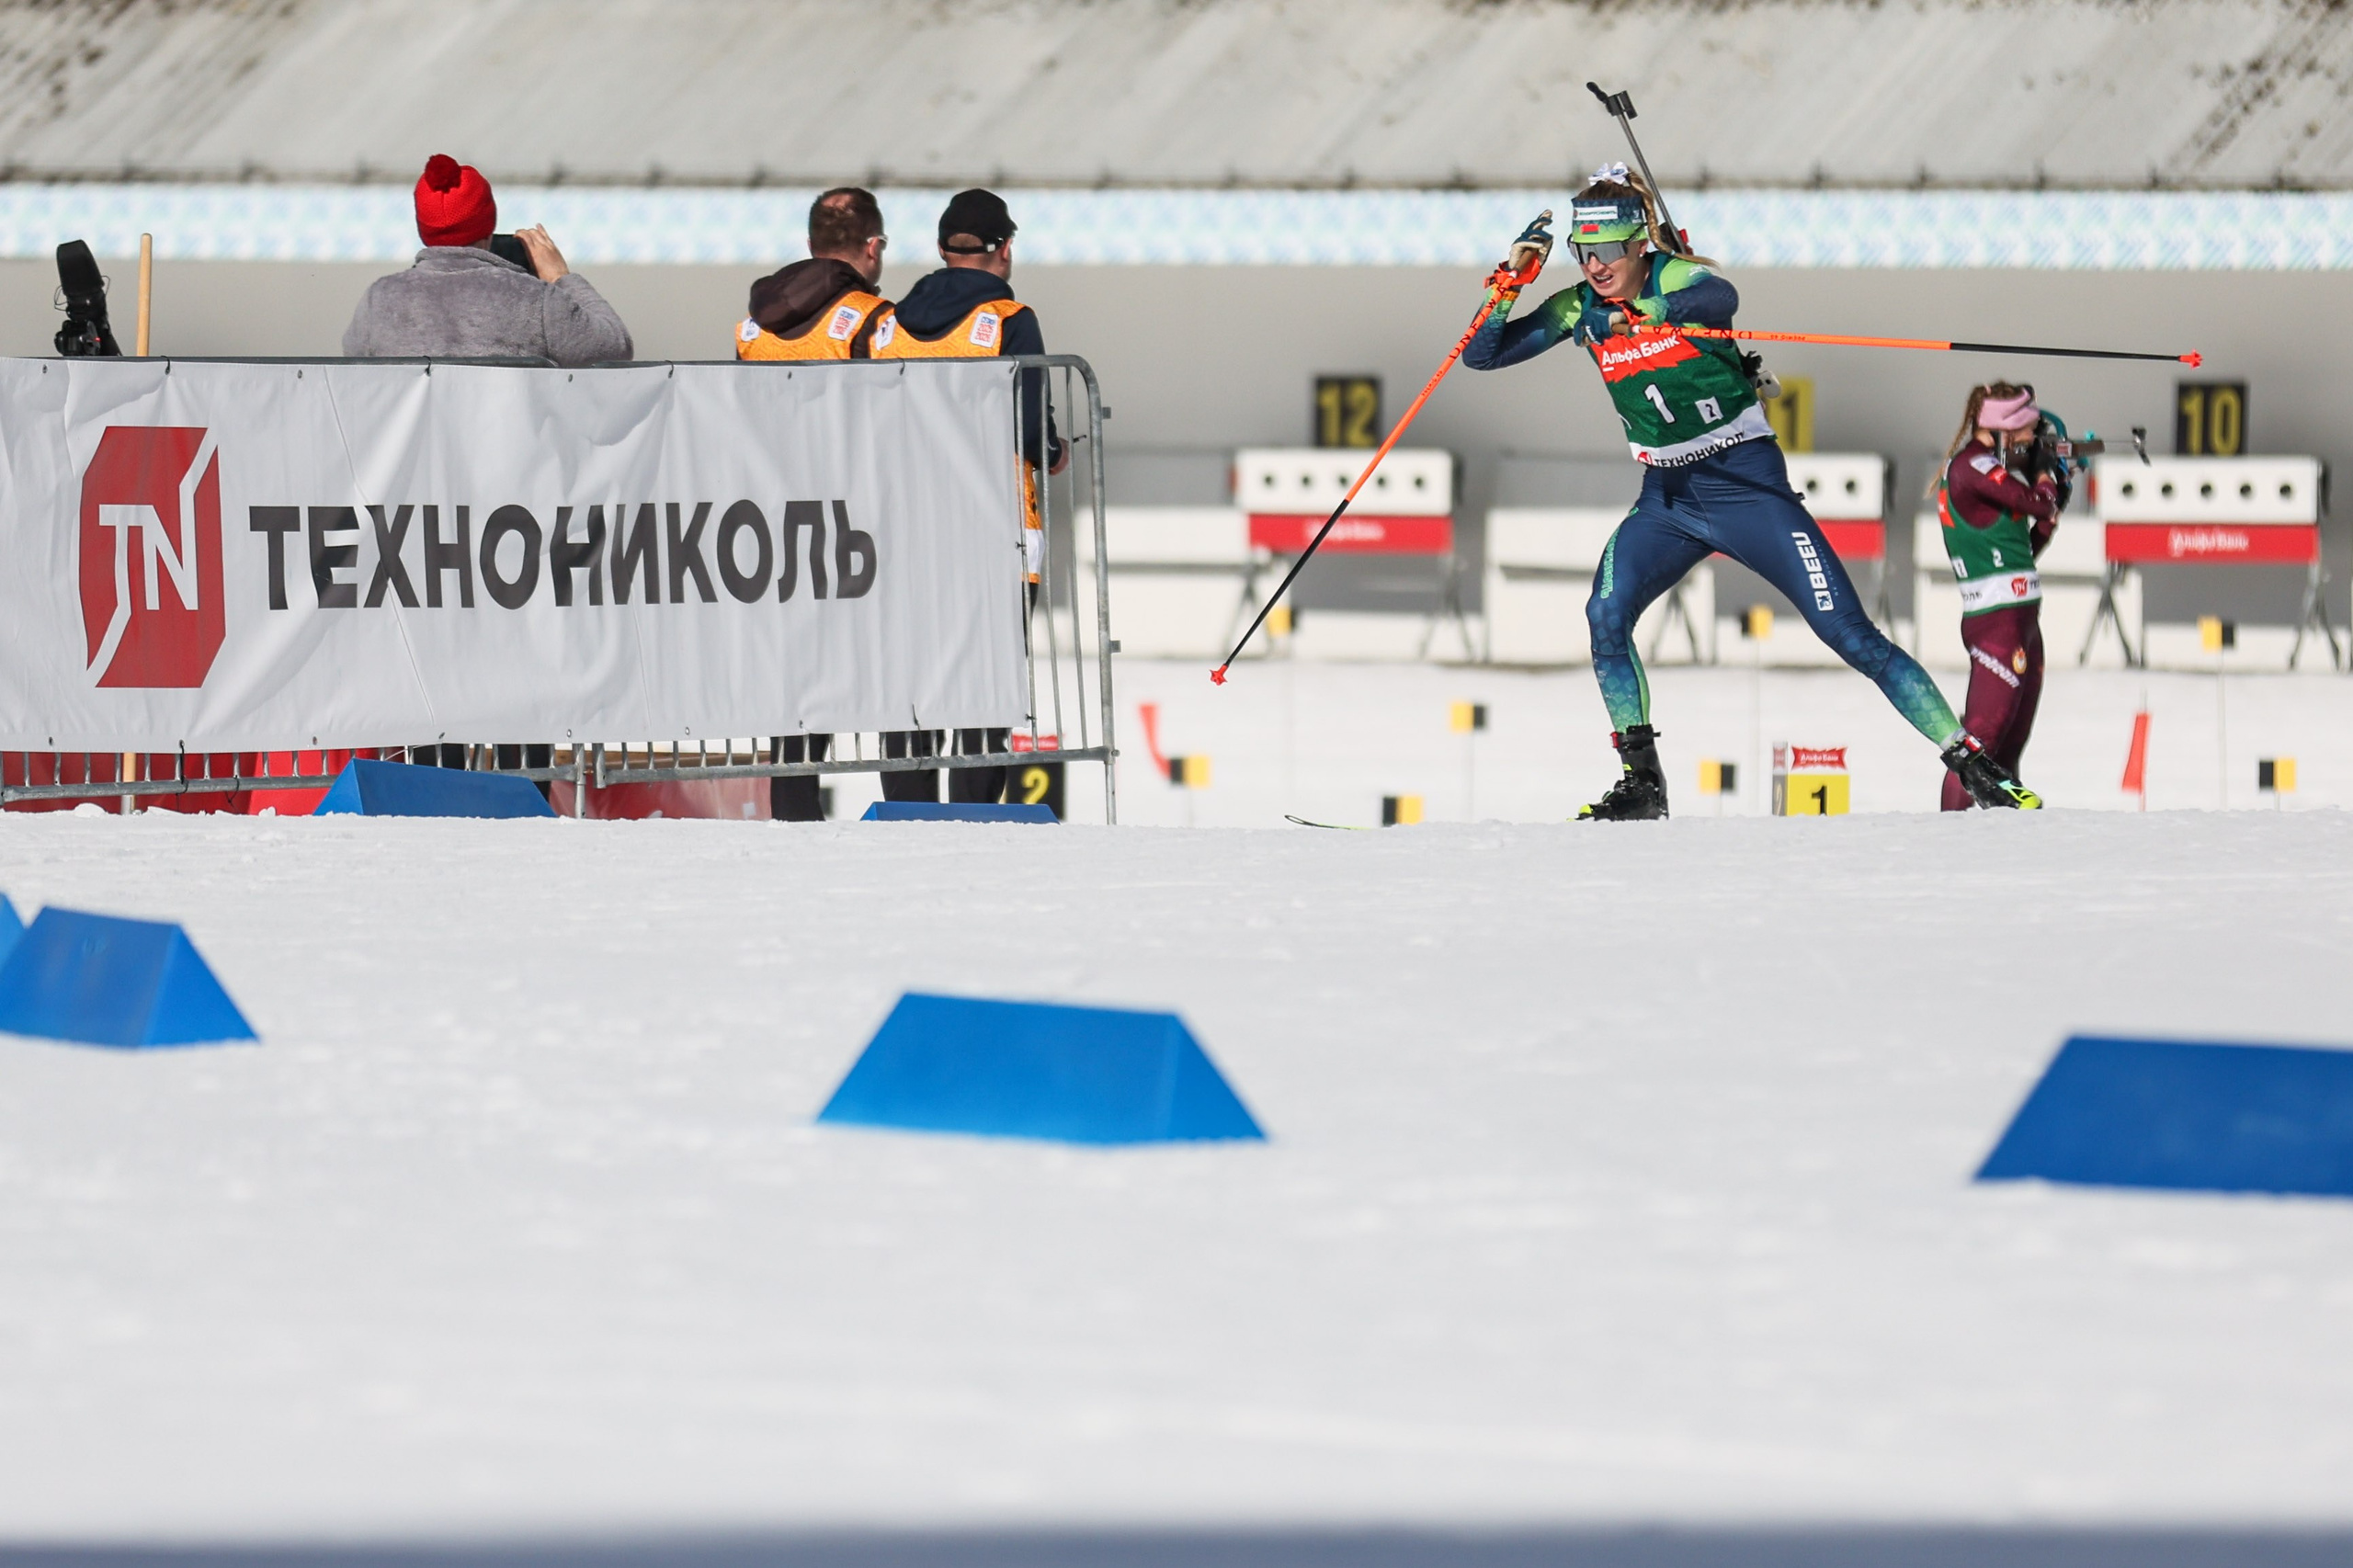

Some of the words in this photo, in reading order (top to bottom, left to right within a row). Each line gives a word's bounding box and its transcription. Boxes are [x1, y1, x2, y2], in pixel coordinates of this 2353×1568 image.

[1318, 381, 1377, 448] 12
[1644, 383, 1676, 424] 1
[1705, 403, 1716, 418] 2
[2183, 388, 2240, 457] 10
[1654, 431, 1745, 468] ТЕХНОНИКОЛ
[249, 499, 878, 611] ТЕХНОНИКОЛЬ
[1991, 547, 2005, 568] 2
[1022, 766, 1049, 804] 2
[1811, 785, 1827, 816] 1
